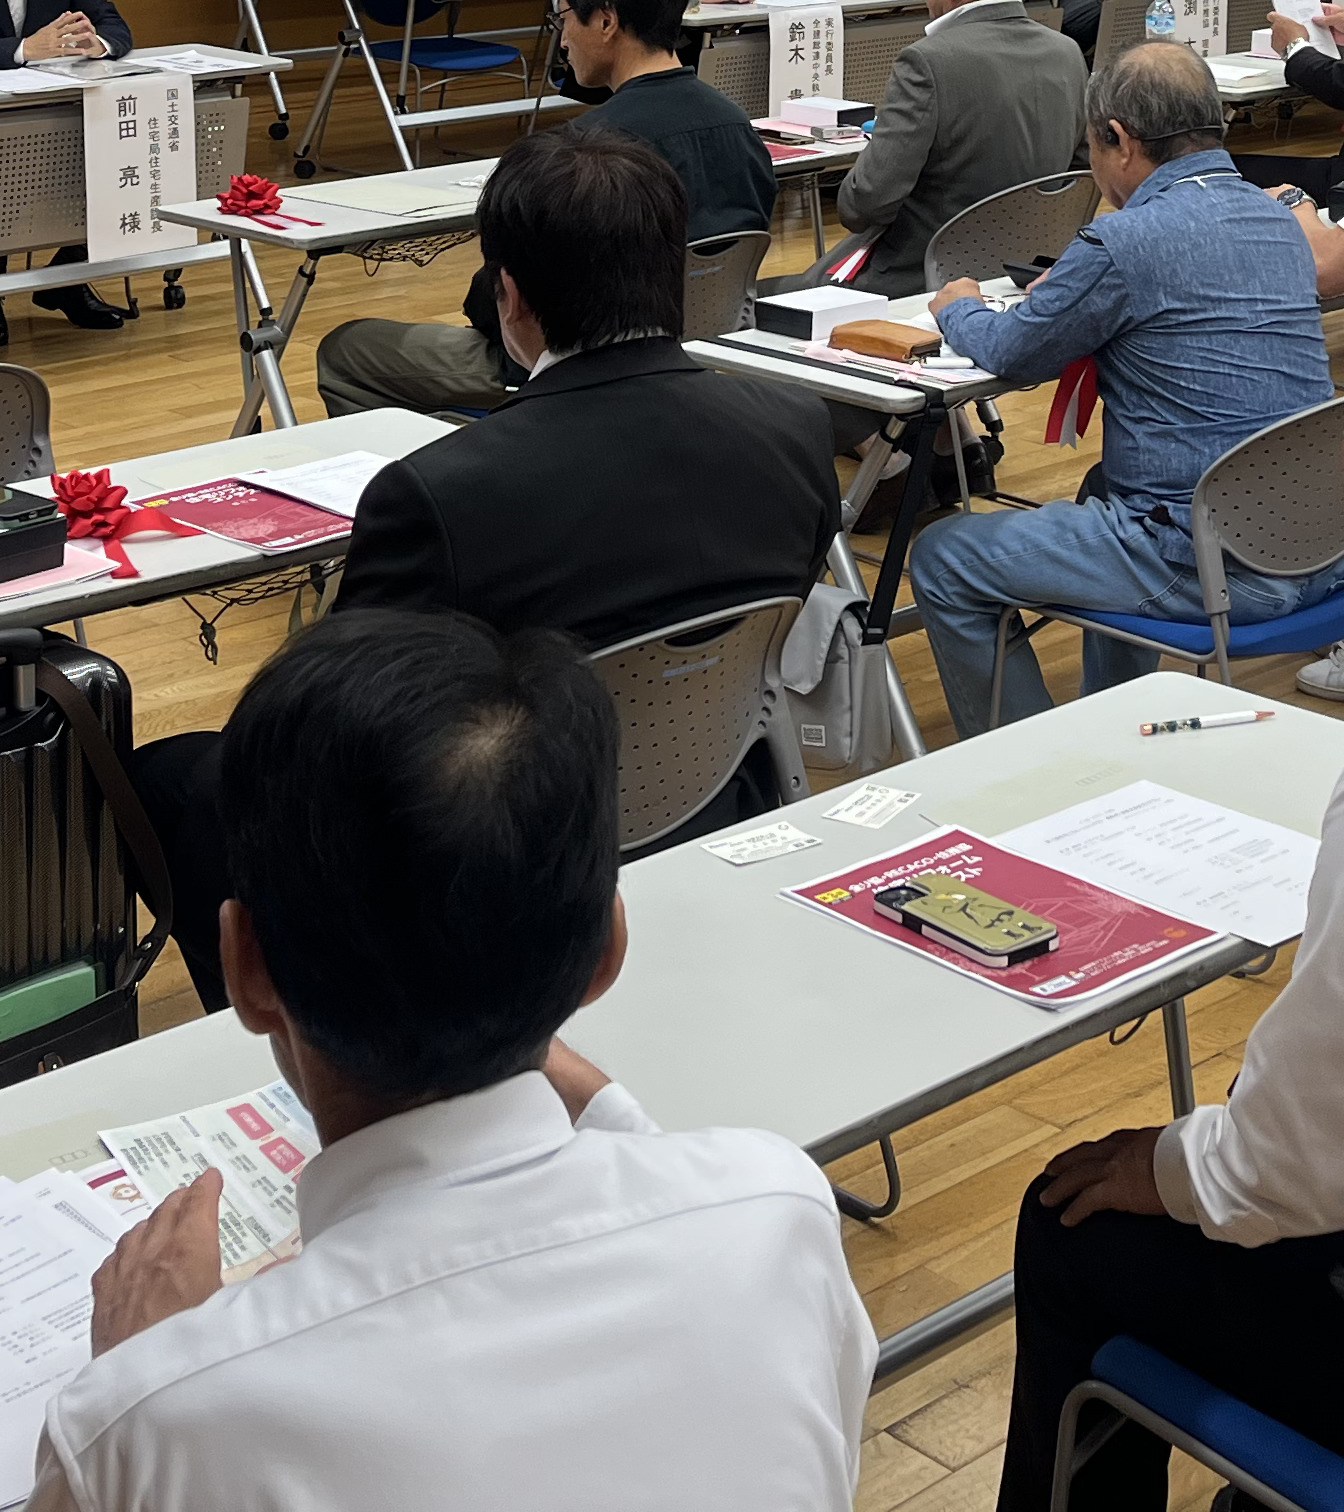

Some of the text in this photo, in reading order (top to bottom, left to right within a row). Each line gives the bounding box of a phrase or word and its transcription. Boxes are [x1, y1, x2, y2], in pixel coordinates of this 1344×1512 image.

[788, 21, 805, 65] 鈴木
[824, 17, 834, 76] 実行委員長
[116, 94, 142, 235] 前田 亮 様
